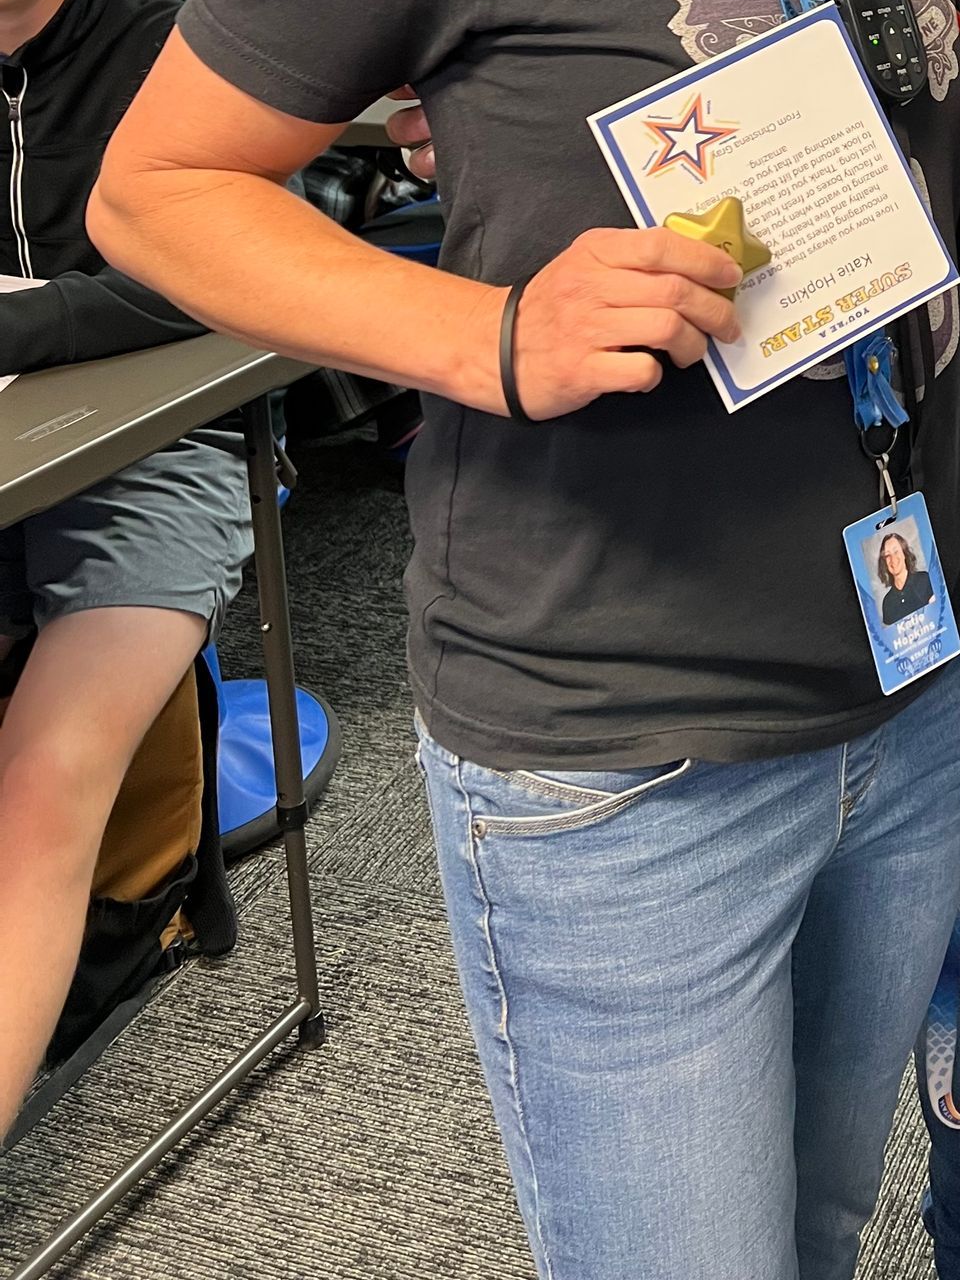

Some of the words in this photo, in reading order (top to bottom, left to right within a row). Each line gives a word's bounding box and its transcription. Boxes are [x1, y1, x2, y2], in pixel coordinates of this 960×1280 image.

[876, 62, 891, 71] SELECT
[776, 109, 802, 127] From
[844, 120, 864, 134] love
[860, 130, 872, 140] to
[803, 129, 845, 155] watching
[840, 135, 862, 150] look
[857, 139, 877, 156] just
[709, 144, 733, 160] Gray
[791, 151, 805, 163] all
[809, 146, 841, 168] around
[872, 152, 883, 162] in
[754, 165, 773, 180] you
[772, 157, 792, 172] that
[791, 162, 809, 177] and
[807, 163, 837, 182] Thank
[843, 157, 873, 178] faculty
[739, 176, 755, 187] do.
[777, 171, 792, 184] lift
[790, 175, 808, 190] you
[815, 173, 844, 192] boxes
[850, 163, 888, 189] amazing
[720, 185, 741, 200] You
[751, 179, 778, 197] those
[777, 186, 791, 199] for
[805, 188, 815, 198] or
[840, 183, 852, 193] to
[848, 181, 880, 205] healthy
[695, 193, 721, 212] really
[743, 192, 776, 215] always
[780, 194, 805, 211] fresh
[813, 189, 841, 208] watch
[760, 206, 781, 222] fruit
[788, 204, 813, 221] when
[829, 199, 848, 215] and
[834, 192, 888, 225] encouraging
[874, 203, 894, 218] love
[746, 217, 760, 228] on
[770, 214, 788, 230] you
[813, 209, 831, 222] live
[855, 214, 875, 229] how
[778, 217, 815, 240] healthy.
[805, 221, 835, 241] others
[837, 222, 855, 237] you
[763, 237, 779, 250] Yo
[794, 236, 806, 246] to
[806, 232, 837, 255] always
[771, 242, 795, 259] think
[782, 250, 807, 268] think
[836, 252, 872, 279] Katie
[755, 271, 767, 283] of
[765, 263, 783, 277] out
[738, 278, 756, 290] the
[777, 271, 836, 310] Hopkins
[834, 261, 913, 314] SUPER
[828, 306, 870, 333] YOU'RE
[758, 304, 835, 358] STAR!
[817, 329, 826, 338] A
[896, 613, 925, 634] Katie
[893, 621, 936, 650] Hopkins
